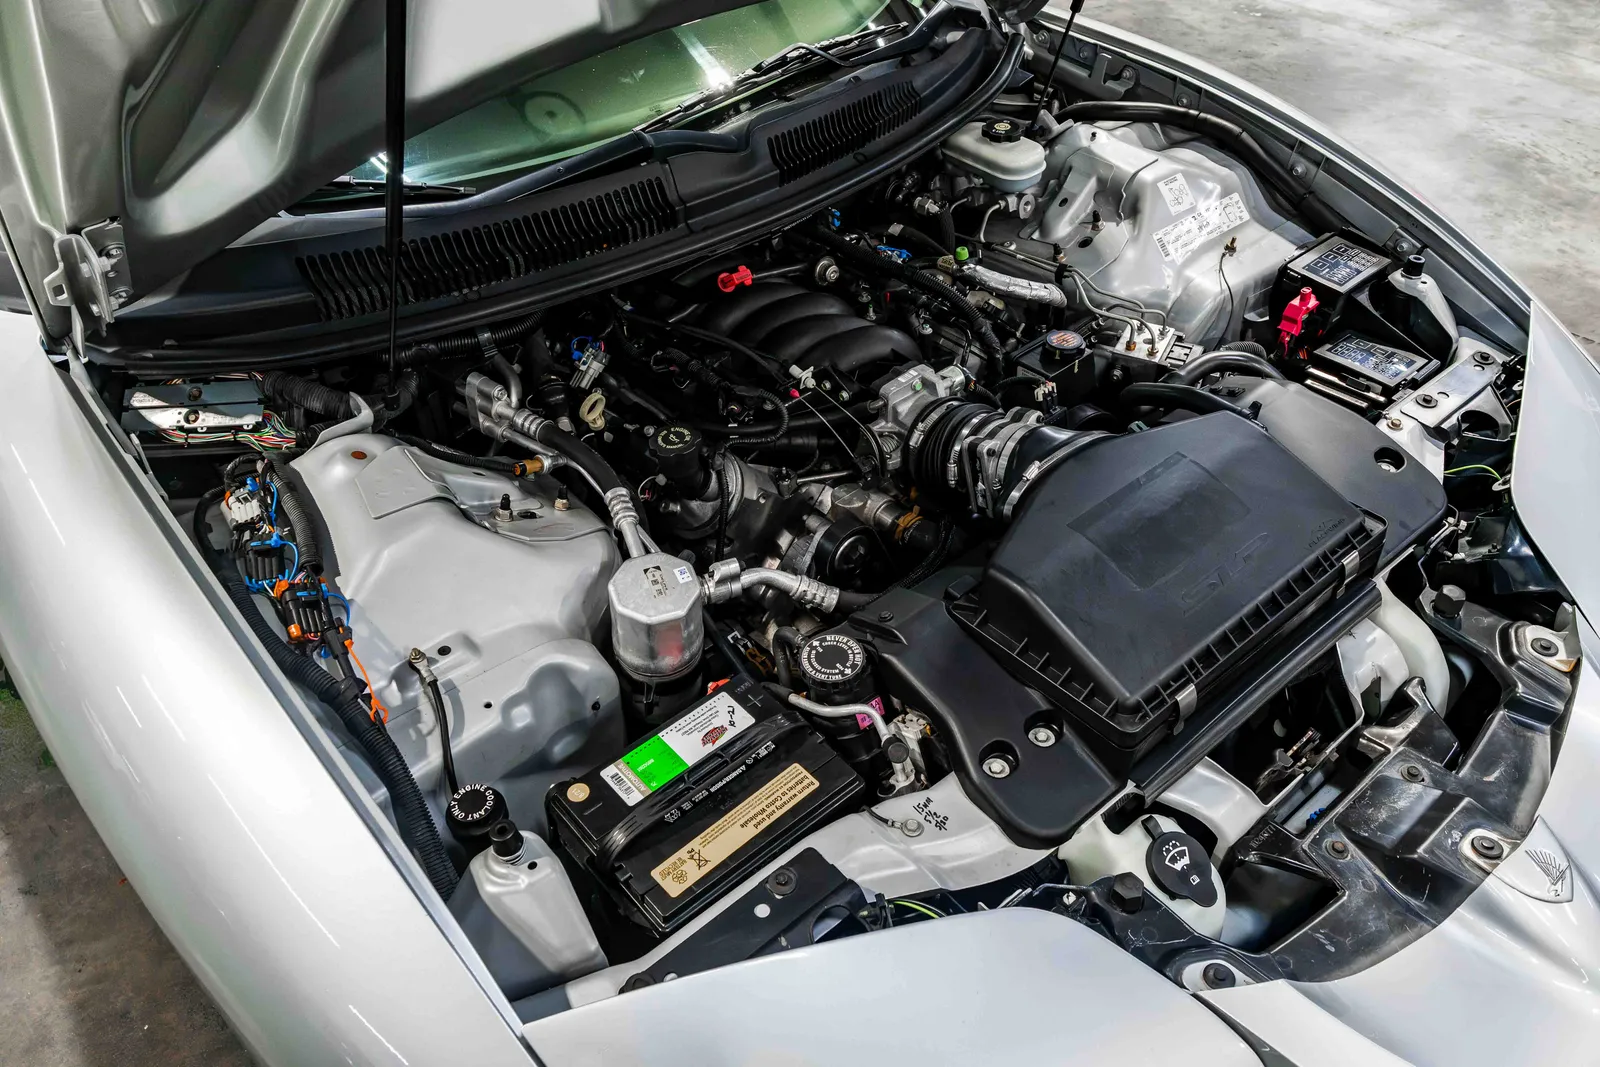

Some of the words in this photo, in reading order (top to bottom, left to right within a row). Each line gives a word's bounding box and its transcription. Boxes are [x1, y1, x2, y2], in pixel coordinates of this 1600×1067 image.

[826, 635, 849, 645] NEVER
[453, 783, 488, 799] ENGINE
[786, 773, 809, 795] batteries
[796, 778, 816, 797] Return
[764, 794, 783, 811] Costco
[773, 791, 799, 814] warranty
[780, 790, 789, 799] to
[450, 801, 466, 819] ONLY
[466, 789, 495, 821] COOLANT
[738, 805, 767, 830] Wholesale
[752, 816, 767, 830] used
[765, 808, 778, 821] and
[686, 847, 695, 855] Pb
